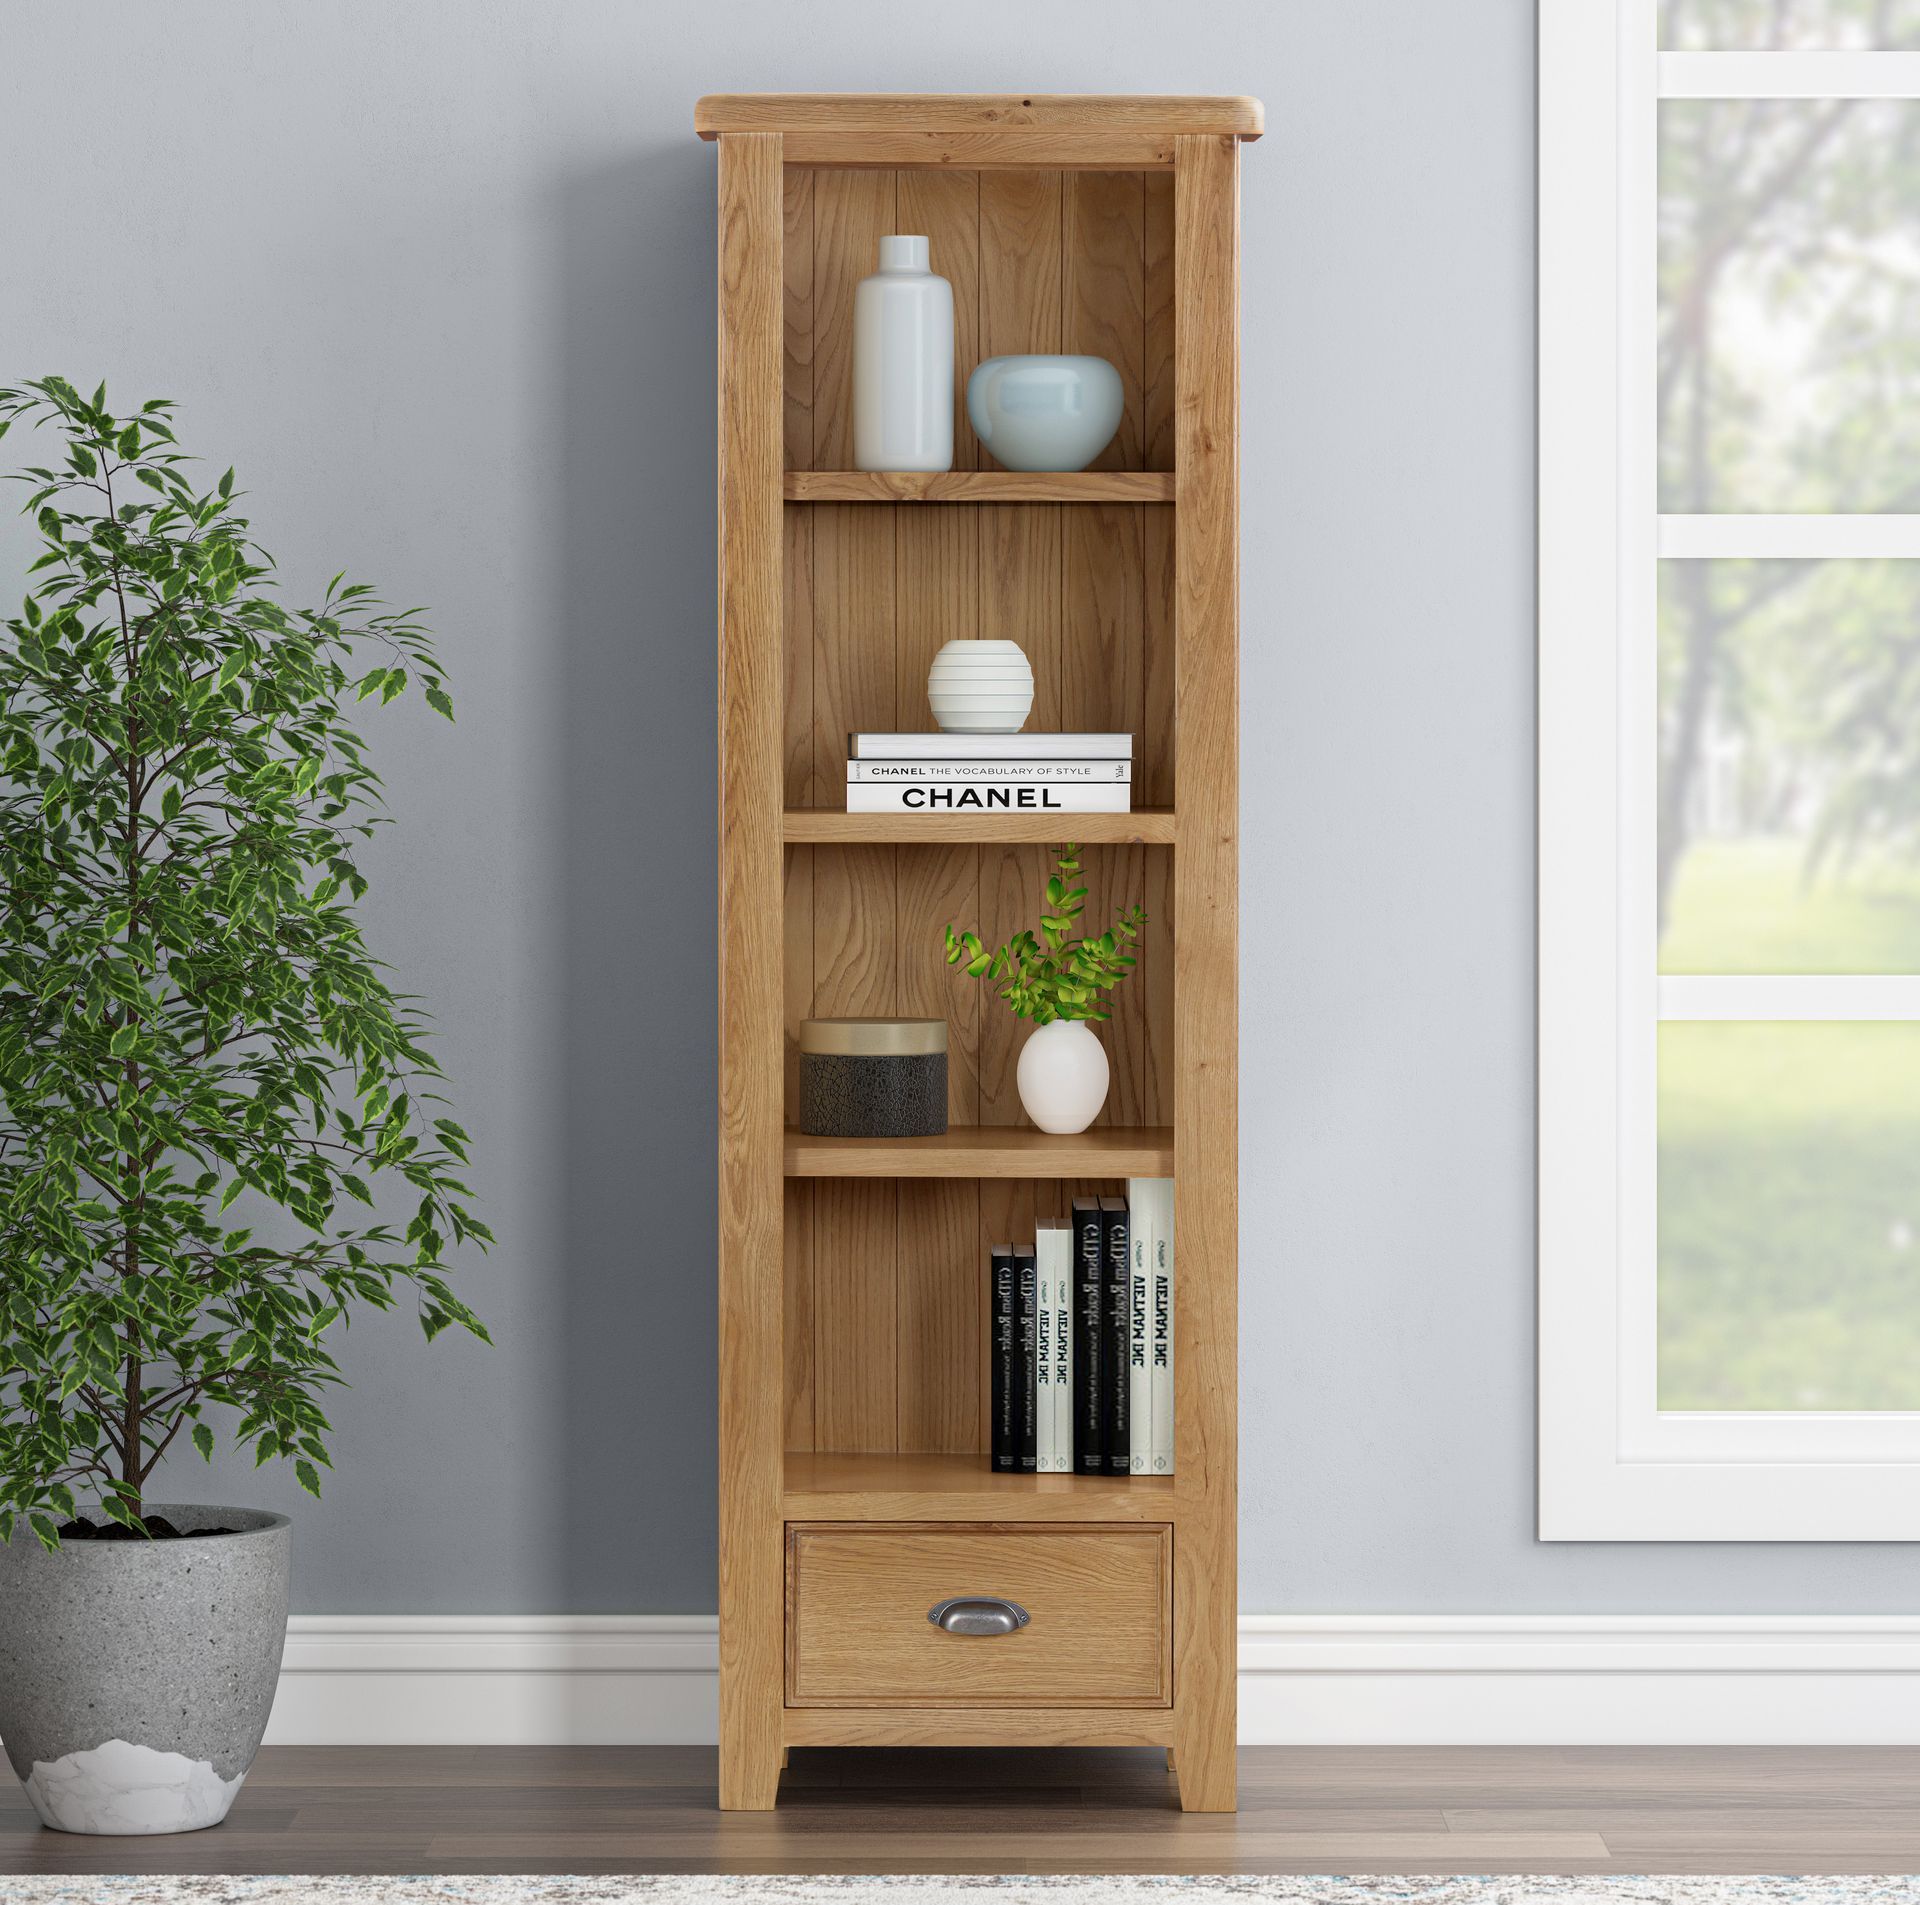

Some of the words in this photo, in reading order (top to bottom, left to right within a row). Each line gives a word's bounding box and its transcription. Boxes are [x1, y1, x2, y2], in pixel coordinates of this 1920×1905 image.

[871, 767, 927, 776] CHANEL
[929, 767, 951, 776] THE
[954, 767, 1033, 776] VOCABULARY
[1036, 767, 1052, 776] OF
[1056, 767, 1091, 776] STYLE
[1115, 764, 1124, 778] Yale
[901, 788, 1062, 809] CHANEL
